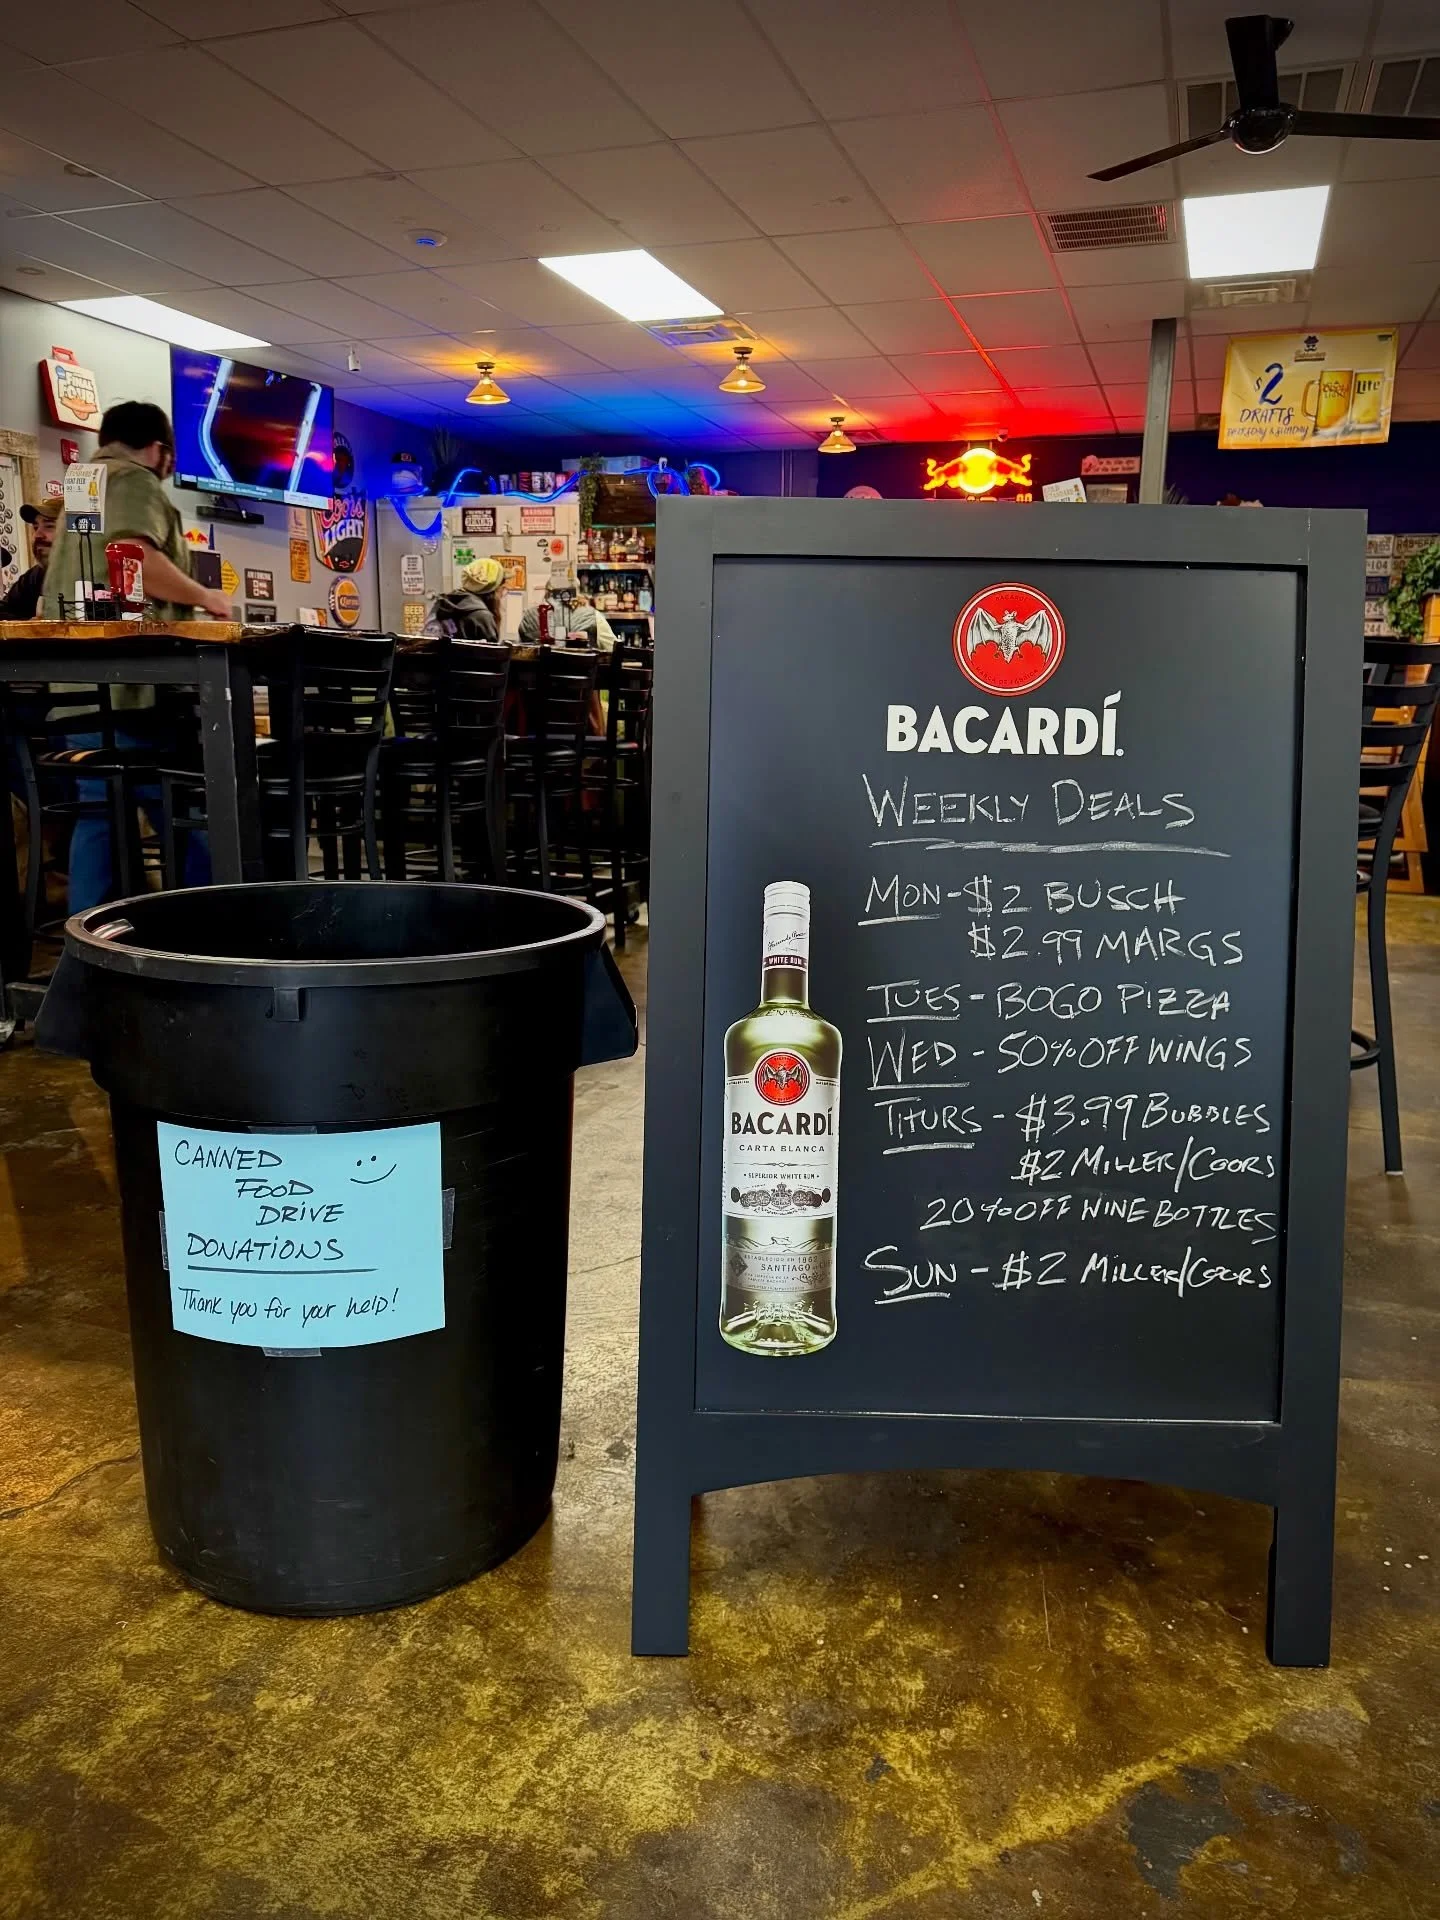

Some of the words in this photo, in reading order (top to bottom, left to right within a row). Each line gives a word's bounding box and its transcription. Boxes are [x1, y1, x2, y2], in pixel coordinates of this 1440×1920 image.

[1254, 362, 1284, 405] $2
[1239, 407, 1296, 425] DRAFTS
[321, 493, 364, 528] Coors
[324, 518, 363, 546] LIGHT
[862, 773, 1030, 828] WEEKLY
[1051, 778, 1197, 830] DEALS
[1043, 878, 1187, 916] BUSCH
[967, 921, 1084, 967] $2.99
[1095, 926, 1244, 968] MARGS
[995, 982, 1103, 1020] BOGO
[1116, 981, 1231, 1020] PIZZA
[1147, 1034, 1253, 1071] WINGS
[1014, 1093, 1139, 1144] $3.99
[1141, 1091, 1272, 1134] BUBBLES
[174, 1139, 284, 1171] CANNED
[739, 1144, 776, 1152] CARTA
[780, 1145, 825, 1153] BLANCA
[1010, 1148, 1062, 1187] $2
[235, 1178, 315, 1199] FOOD
[1080, 1196, 1149, 1223] WINE
[1151, 1203, 1279, 1246] BOTTLES
[761, 1263, 811, 1272] SANTIAGO
[992, 1249, 1068, 1291] $2
[178, 1286, 223, 1316] Thank
[230, 1300, 258, 1325] you
[264, 1296, 292, 1319] for
[302, 1302, 337, 1329] your
